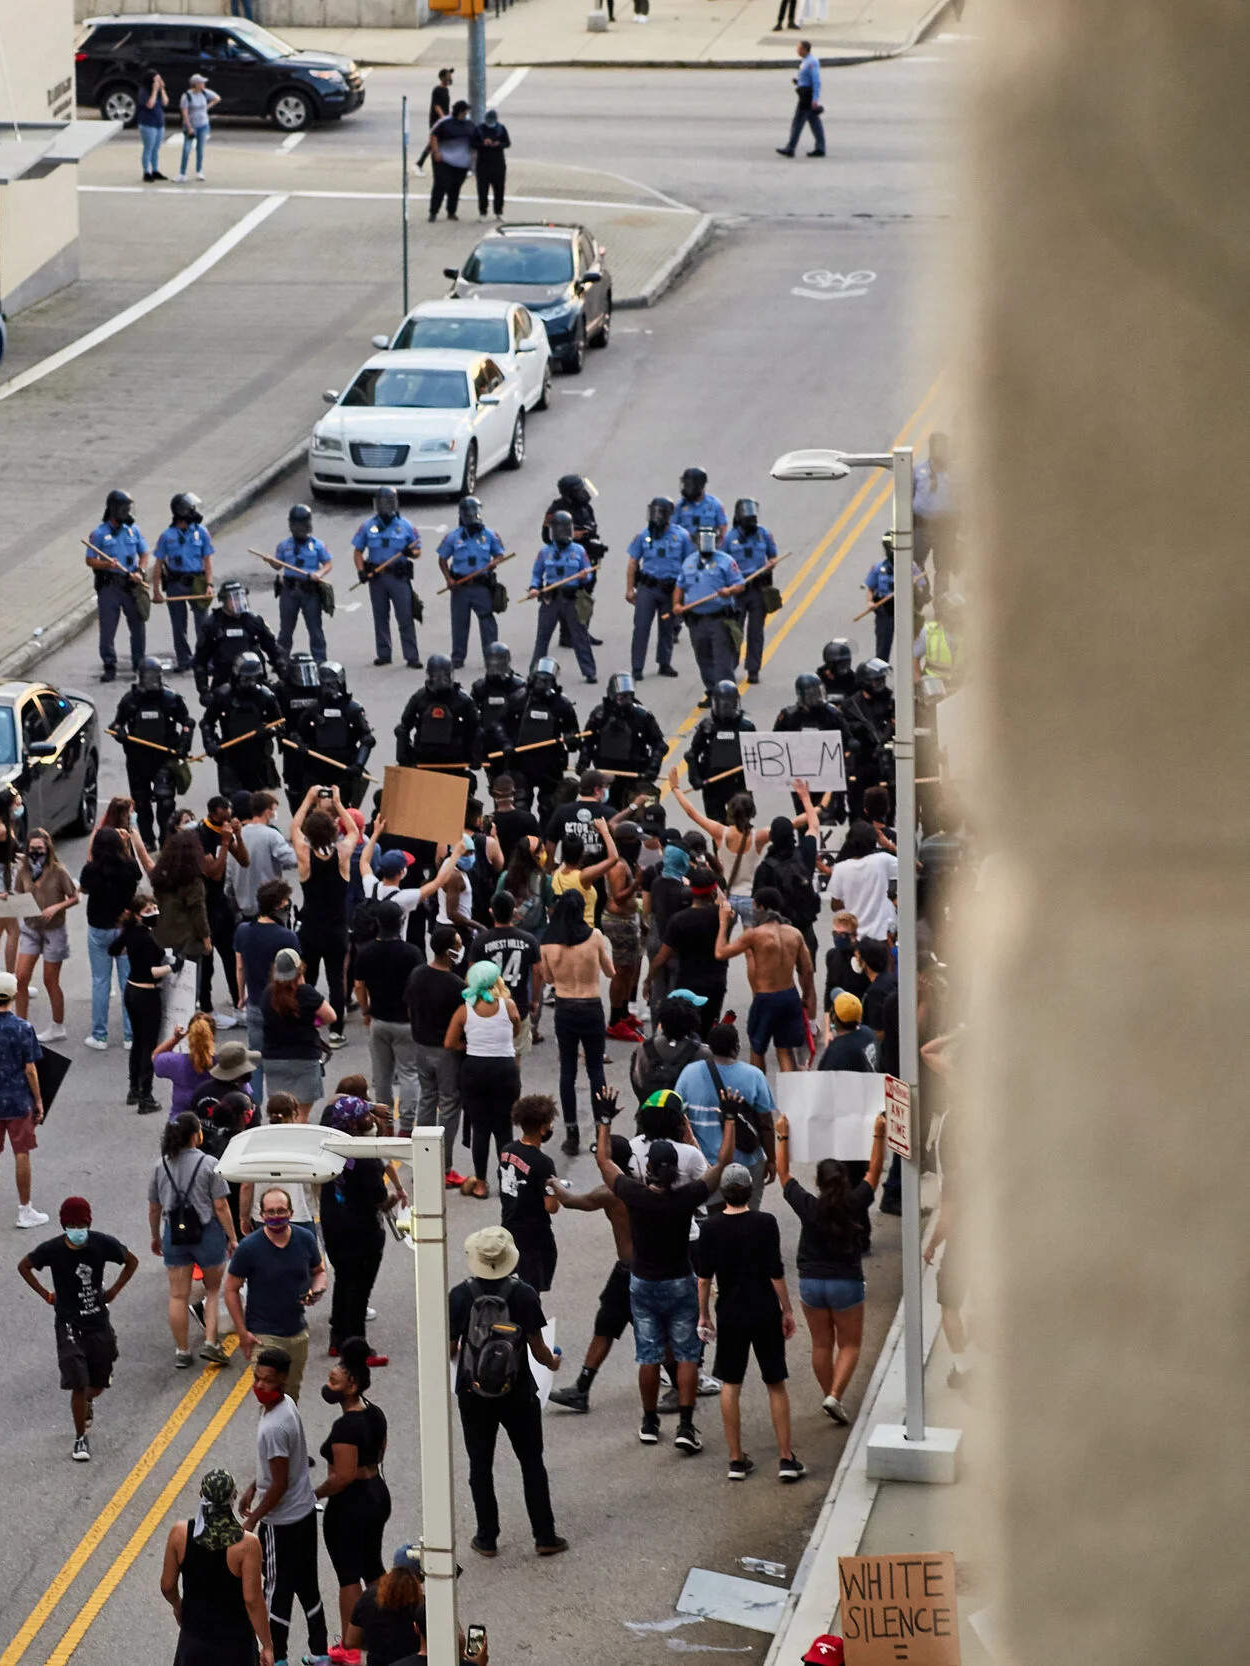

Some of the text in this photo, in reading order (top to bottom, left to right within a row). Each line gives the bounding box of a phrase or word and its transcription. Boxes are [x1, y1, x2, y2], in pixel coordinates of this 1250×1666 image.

[744, 740, 843, 779] #BLM
[484, 938, 525, 953] FOREST HILLS
[491, 950, 521, 987] 14
[890, 1119, 906, 1139] TIME
[891, 1103, 904, 1120] ANY
[839, 1561, 944, 1601] WHITE
[845, 1605, 951, 1643] SILENCE
